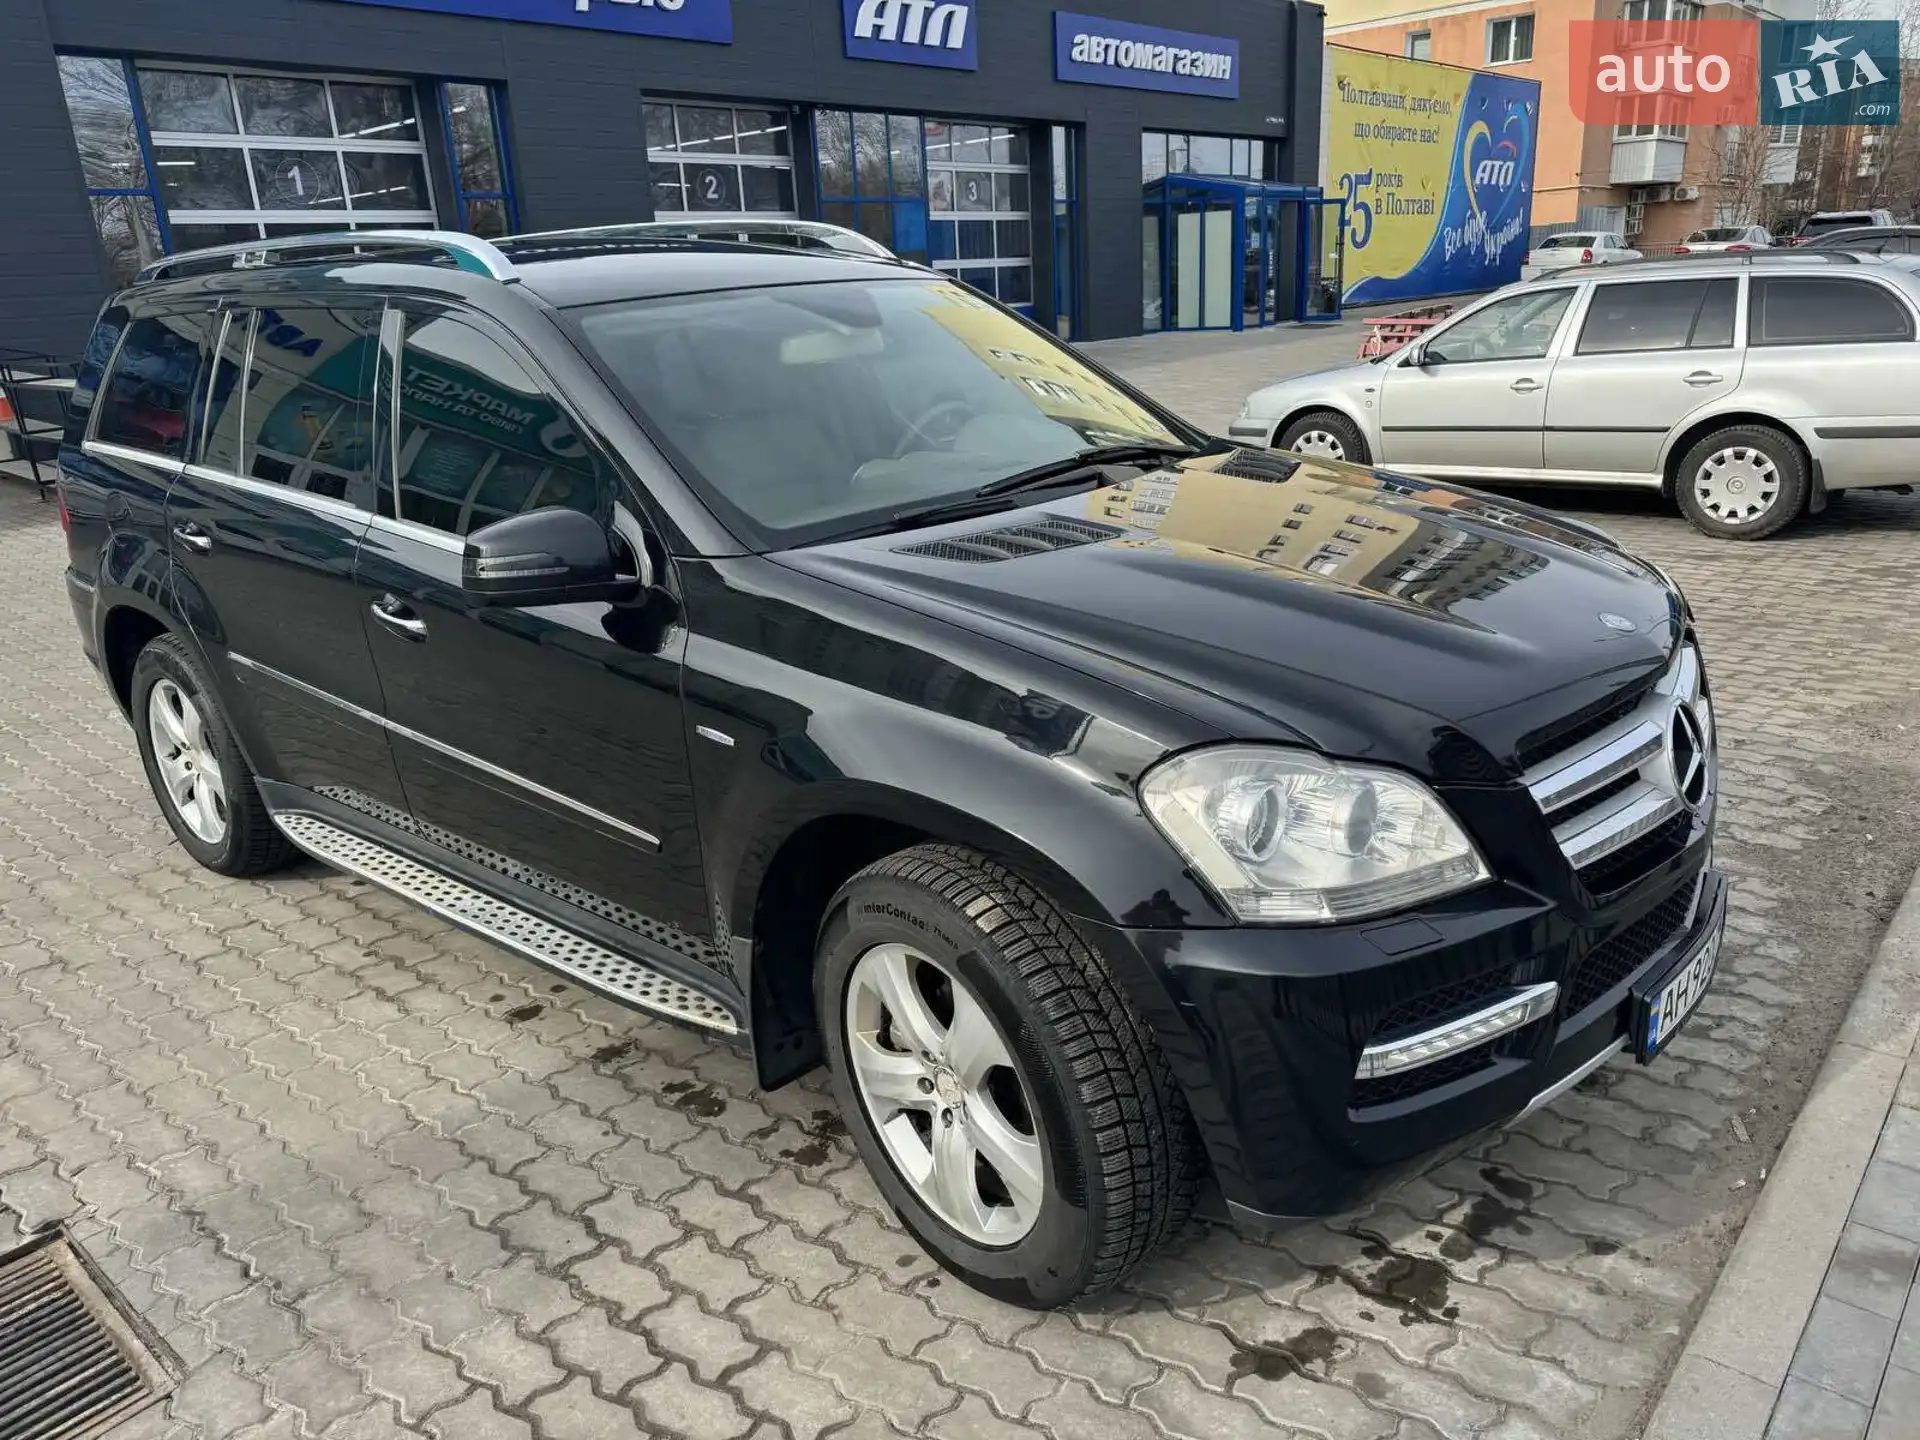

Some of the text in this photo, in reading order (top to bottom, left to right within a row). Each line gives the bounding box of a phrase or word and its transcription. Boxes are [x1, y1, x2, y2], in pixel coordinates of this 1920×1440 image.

[854, 0, 968, 49] АТЛ
[1071, 33, 1232, 80] автомагазин
[1354, 119, 1441, 147] що обираєте нас!
[287, 165, 305, 196] 1
[704, 175, 719, 199] 2
[967, 181, 978, 201] 3
[1375, 168, 1403, 193] років
[1339, 168, 1373, 250] 25
[1375, 192, 1435, 217] в Полтаві
